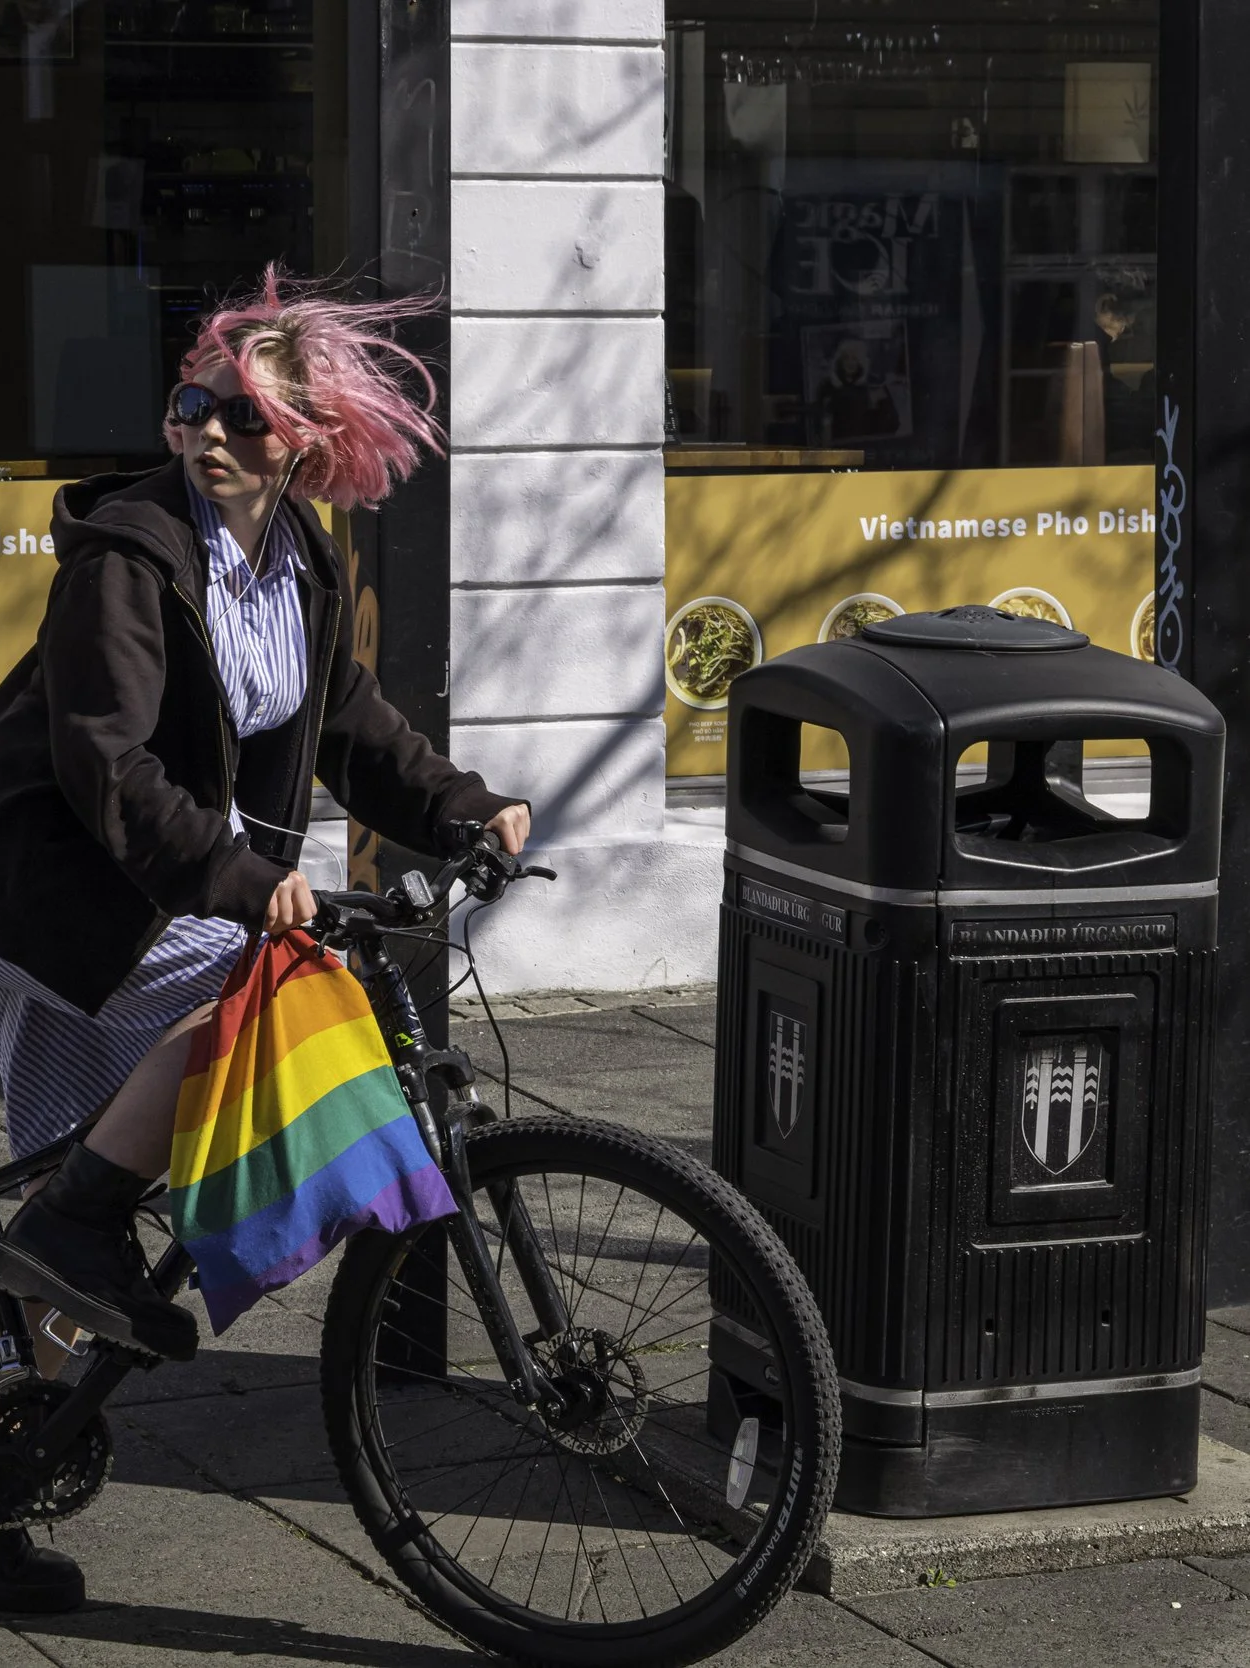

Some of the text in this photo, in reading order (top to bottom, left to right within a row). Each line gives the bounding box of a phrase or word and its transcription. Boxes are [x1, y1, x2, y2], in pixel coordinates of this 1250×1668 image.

[859, 508, 1156, 541] Vietnamese Pho Dish
[742, 885, 842, 933] BLANDAÐUR ÚRGGUR
[1071, 922, 1167, 943] ÚRGANGUR
[743, 1528, 781, 1587] RANGER
